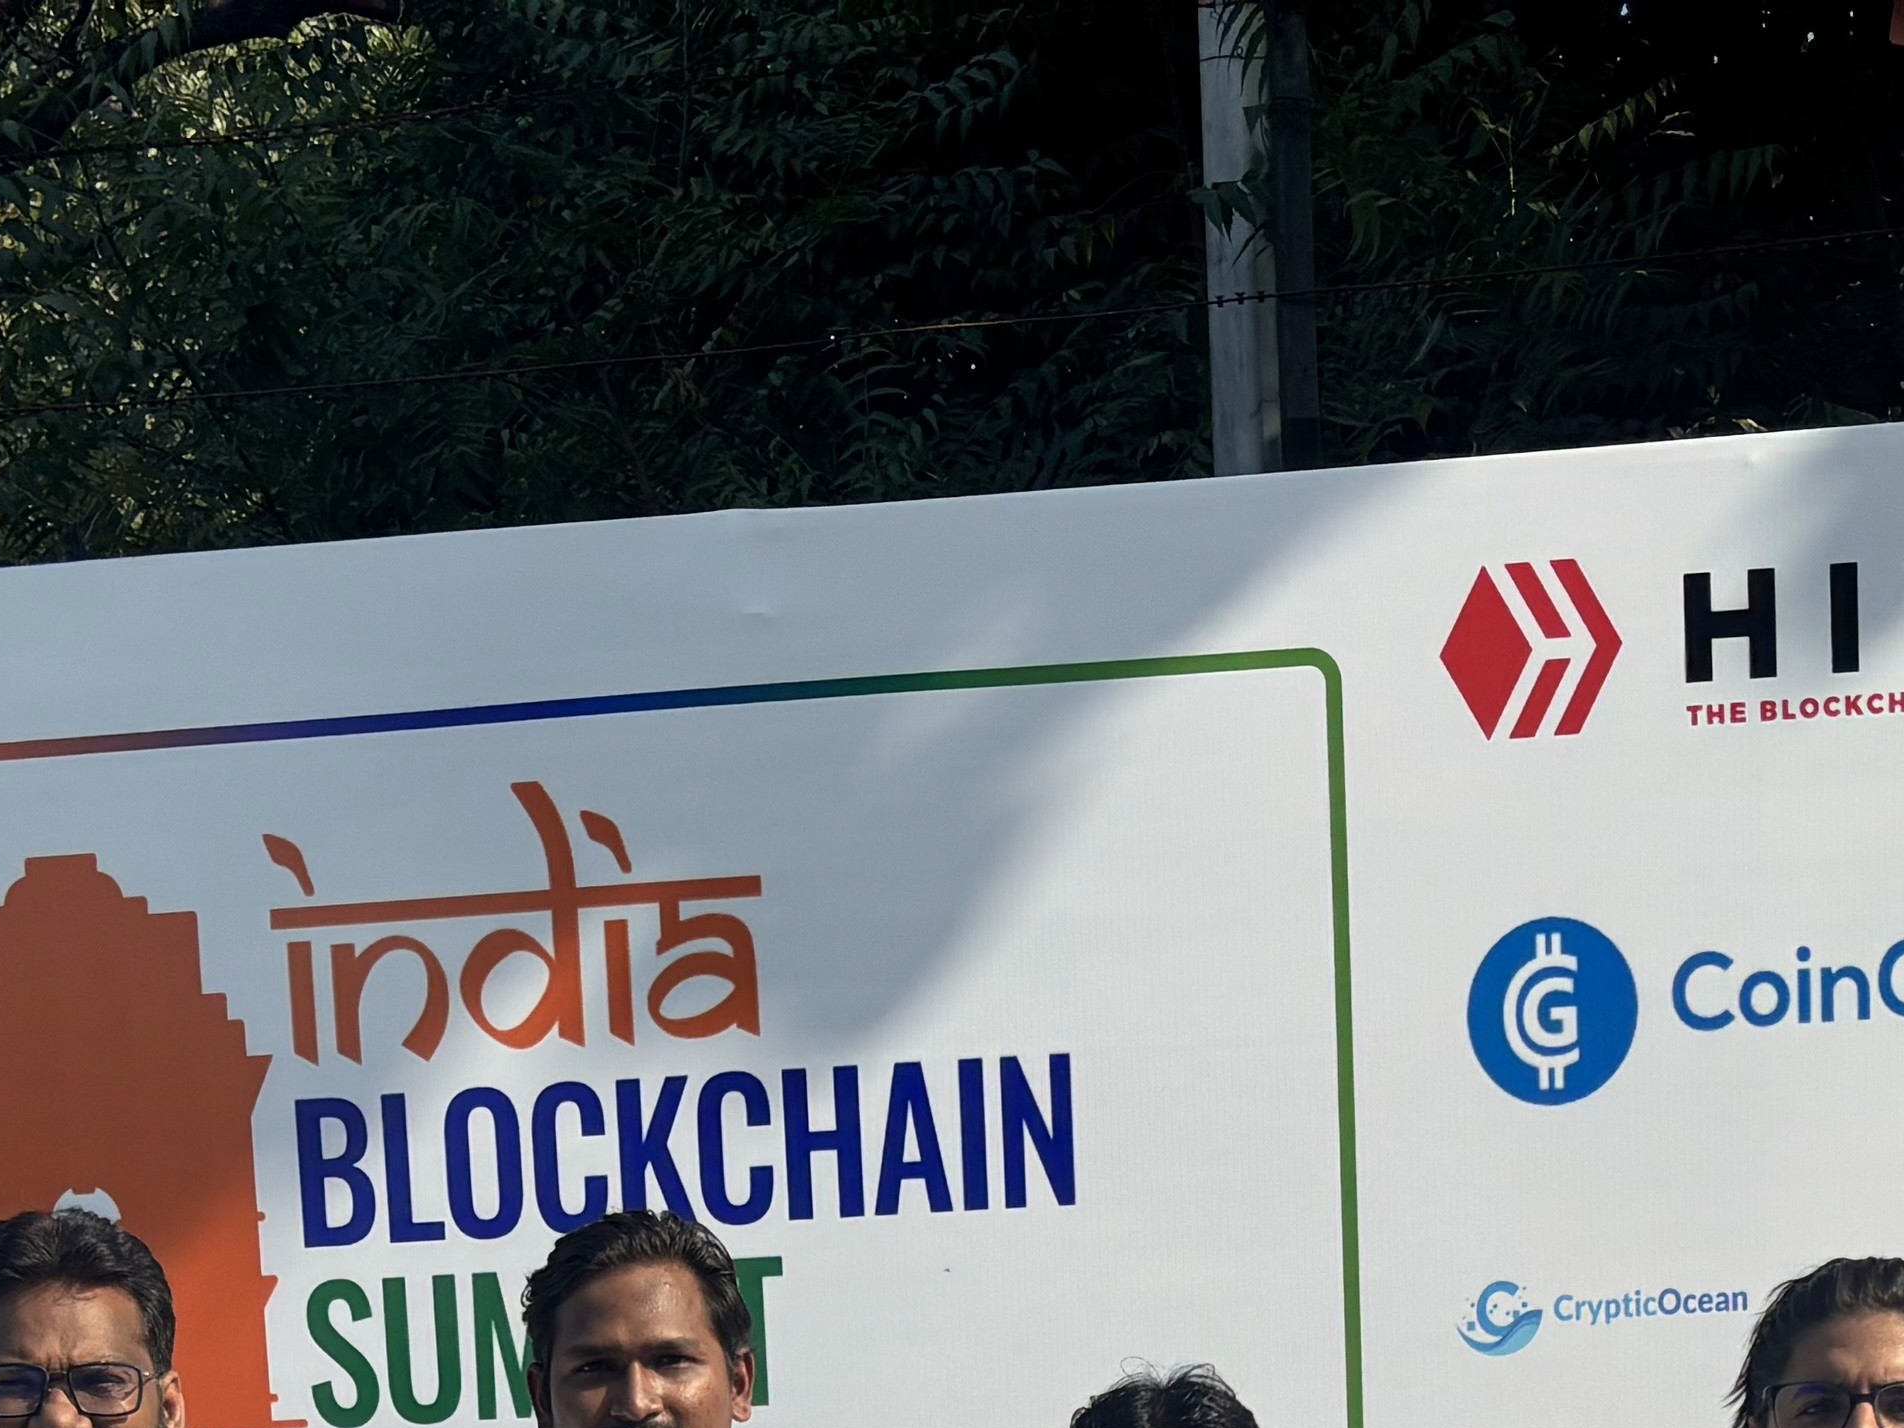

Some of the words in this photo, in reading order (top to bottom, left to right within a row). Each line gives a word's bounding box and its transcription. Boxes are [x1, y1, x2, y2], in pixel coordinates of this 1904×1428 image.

[1686, 700, 1747, 727] THE
[262, 781, 761, 1066] india
[295, 1053, 1076, 1248] BLOCKCHAIN
[307, 1256, 782, 1428] SUMT
[1553, 1287, 1748, 1327] CrypticOcean
